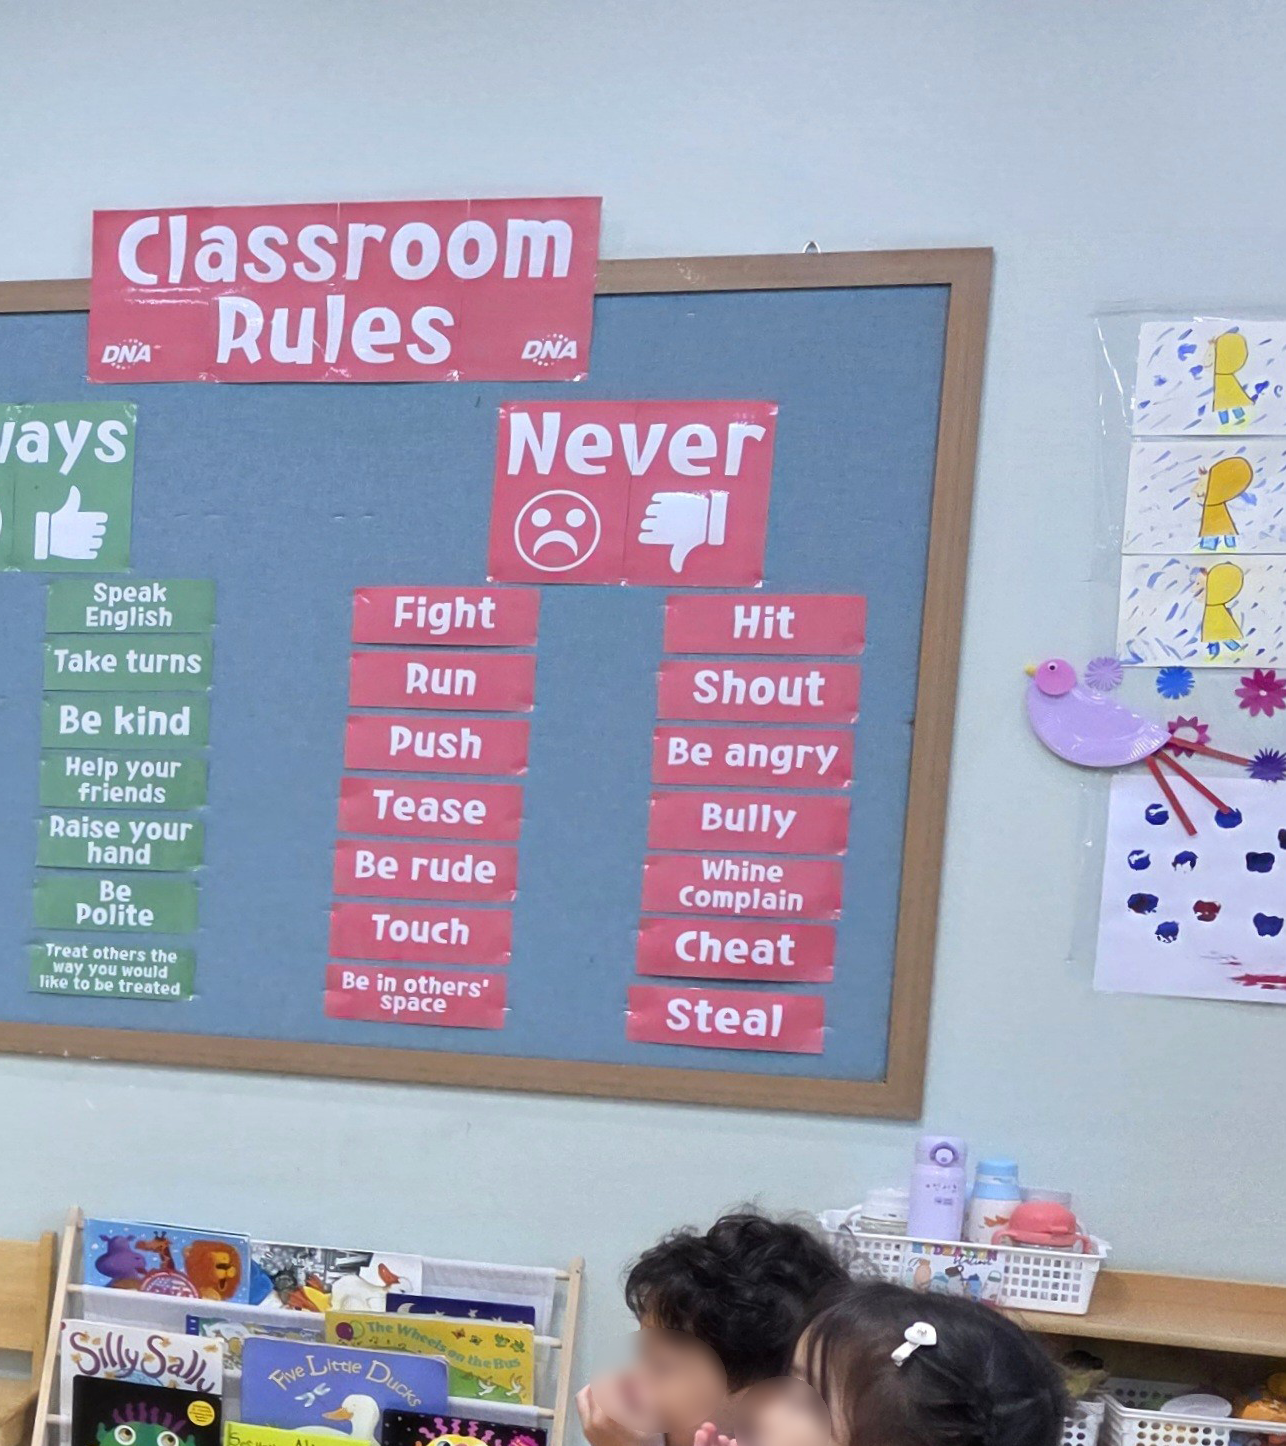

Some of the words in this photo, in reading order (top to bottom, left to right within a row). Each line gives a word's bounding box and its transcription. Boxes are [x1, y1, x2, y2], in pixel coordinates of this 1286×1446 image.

[118, 215, 573, 284] Classroom
[217, 295, 454, 364] Rules
[102, 344, 151, 364] DNA
[521, 339, 577, 360] DNA
[507, 412, 766, 476] Never
[93, 583, 167, 606] Speak
[86, 607, 172, 630] English
[394, 597, 495, 635] Fight
[733, 605, 795, 639] Hit
[54, 649, 117, 673] Take
[127, 651, 201, 674] turns
[407, 663, 476, 696] Run
[693, 670, 825, 706] Shout
[59, 705, 101, 734] Be
[114, 706, 189, 735] kind
[390, 726, 482, 759] Push
[668, 738, 710, 766] Be
[725, 742, 838, 775] angry
[66, 757, 118, 781] Help
[127, 759, 180, 783] your
[78, 782, 166, 803] friends
[373, 789, 487, 824] Tease
[50, 815, 120, 838] Raise
[129, 819, 192, 843] your
[702, 804, 796, 839] Bully
[87, 842, 150, 864] hand
[355, 851, 398, 880] Be
[411, 854, 496, 883] rude
[702, 860, 784, 882] Whine
[100, 880, 131, 902] Be
[679, 885, 803, 913] Complain
[77, 902, 154, 927] Polite
[372, 914, 469, 946] Touch
[46, 943, 87, 958] Treat
[93, 945, 145, 961] others
[151, 948, 177, 963] the
[675, 931, 795, 966] Cheat
[53, 961, 85, 977] way
[89, 963, 117, 977] you
[122, 963, 168, 978] would
[40, 975, 68, 988] like
[73, 977, 90, 990] to
[95, 978, 114, 992] be
[118, 980, 180, 995] treated
[342, 972, 369, 990] Be
[377, 974, 397, 991] in
[404, 976, 489, 999] others'
[380, 994, 446, 1013] space
[666, 999, 783, 1037] Steal
[70, 1331, 138, 1378] Silly
[365, 1322, 394, 1334] The
[397, 1323, 449, 1352] Wheels
[448, 1350, 465, 1363] on
[468, 1353, 491, 1368] the
[492, 1358, 521, 1370] Bus
[268, 1366, 305, 1390] Five
[306, 1355, 362, 1376] Little
[366, 1360, 422, 1407] Ducks
[229, 1432, 253, 1446] See
